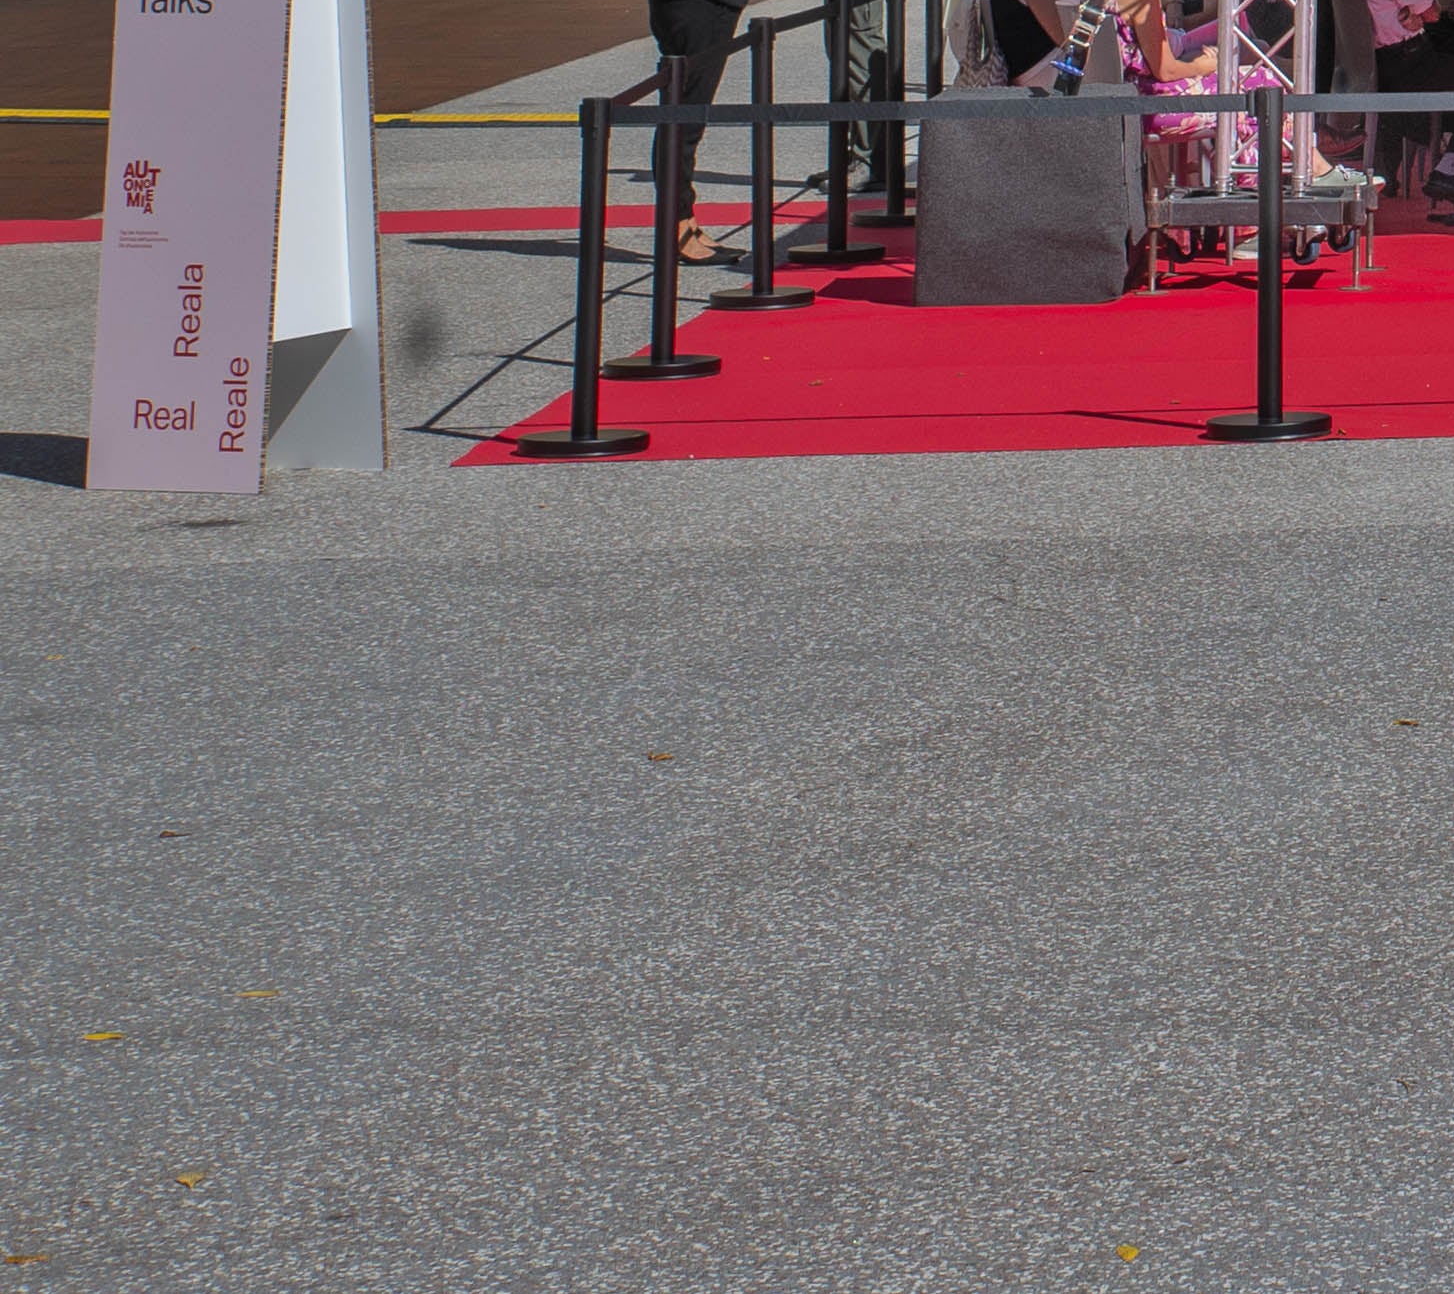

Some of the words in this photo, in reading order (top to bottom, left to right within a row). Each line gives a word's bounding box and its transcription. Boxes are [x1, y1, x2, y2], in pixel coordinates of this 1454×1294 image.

[173, 263, 204, 357] Reala
[133, 398, 196, 431] Real
[218, 357, 250, 453] Reale
